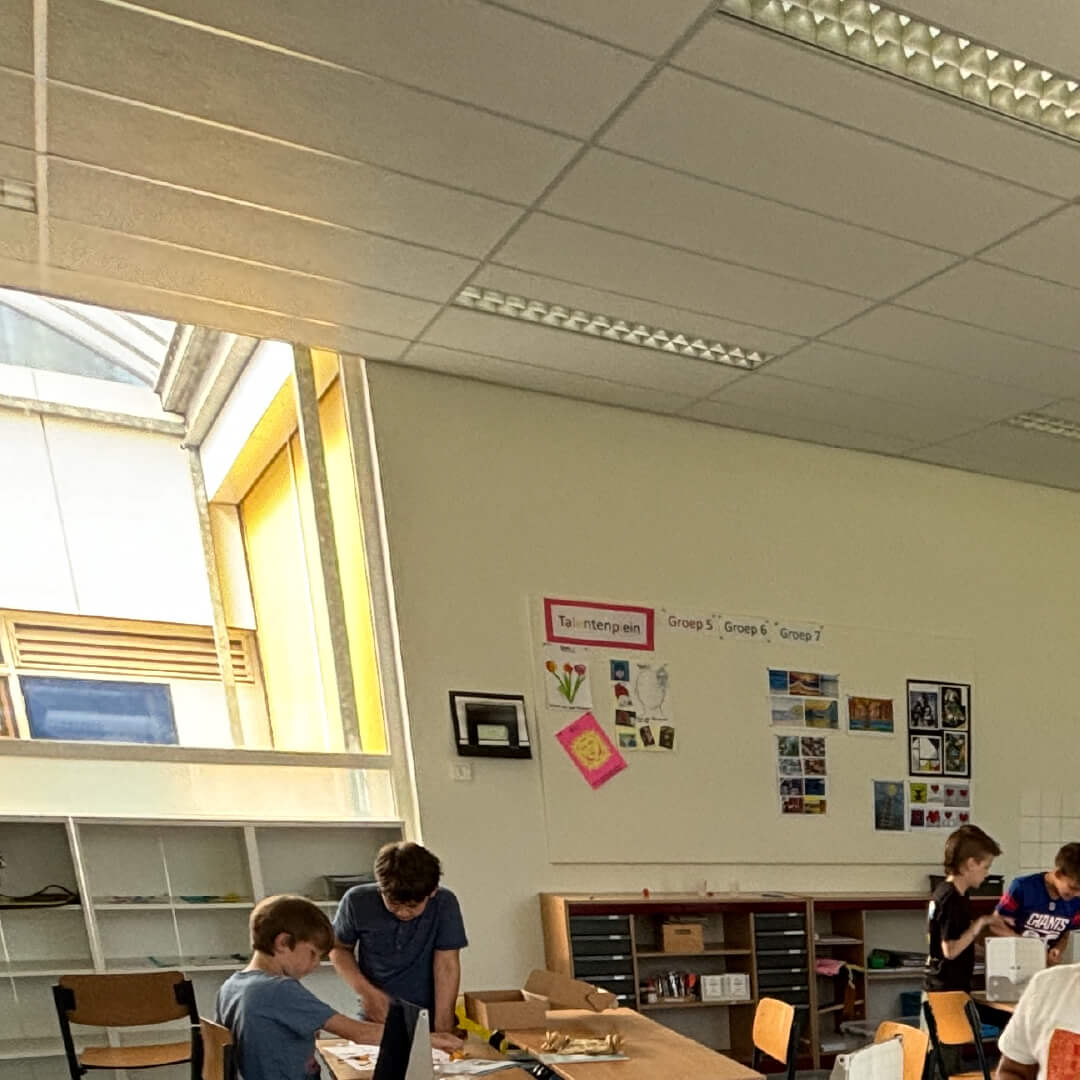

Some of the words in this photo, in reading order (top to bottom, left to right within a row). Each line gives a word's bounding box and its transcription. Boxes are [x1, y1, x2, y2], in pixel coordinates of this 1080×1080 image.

[558, 615, 640, 635] Talntenpein
[668, 615, 703, 632] Groep
[706, 619, 713, 631] 5
[724, 620, 758, 636] Groep
[760, 624, 768, 636] 6
[780, 627, 812, 642] Groep
[814, 630, 821, 641] 7
[1026, 912, 1070, 932] GIANTS
